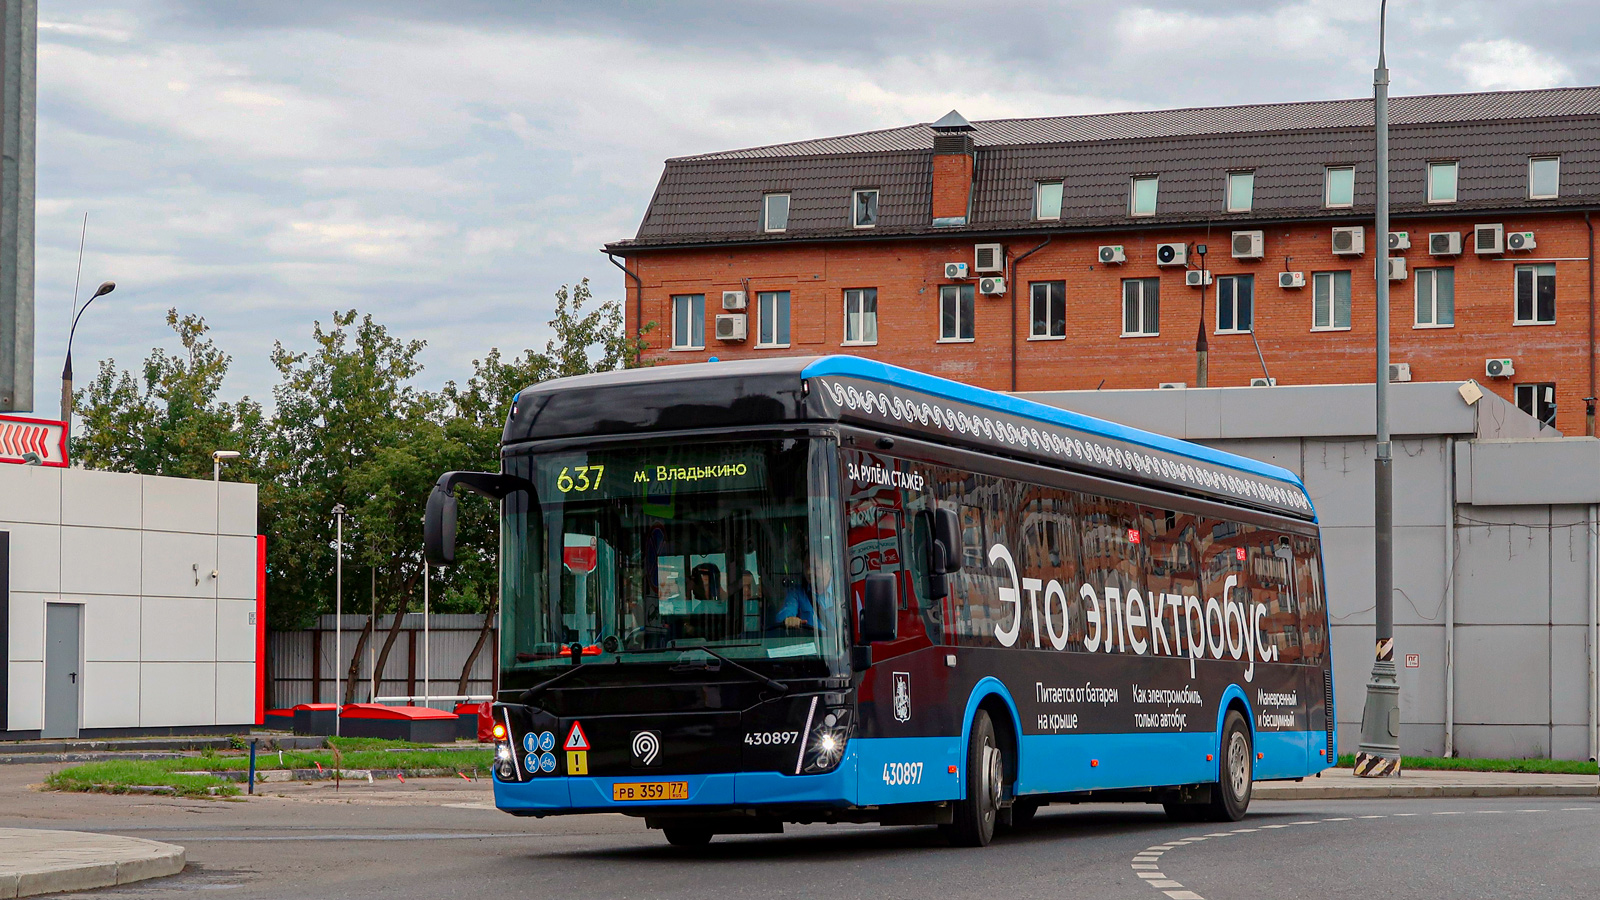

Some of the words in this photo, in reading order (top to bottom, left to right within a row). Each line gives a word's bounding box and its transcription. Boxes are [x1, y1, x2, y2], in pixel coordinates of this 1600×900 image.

[557, 465, 604, 492] 637
[633, 471, 650, 482] м.
[656, 463, 747, 482] Владыкино
[848, 463, 860, 480] ЗА
[861, 463, 891, 485] РУЛЁМ
[891, 471, 924, 491] СТАЖЁР
[988, 543, 1069, 651] Это
[1079, 574, 1278, 682] электробус.
[1036, 682, 1075, 703] Питается
[1076, 687, 1086, 703] от
[1086, 683, 1119, 707] батареи
[1132, 684, 1147, 703] Как
[1148, 687, 1203, 707] электромобиль,
[1257, 688, 1297, 709] Маневренный
[1038, 714, 1049, 729] на
[1049, 714, 1078, 733] крыше
[1134, 713, 1159, 727] только
[1160, 708, 1188, 731] автобус
[1257, 713, 1262, 726] и
[1262, 710, 1295, 730] бесшумный
[744, 731, 799, 746] 430897
[882, 762, 923, 785] 430897
[640, 784, 663, 798] 359
[671, 783, 683, 793] 77
